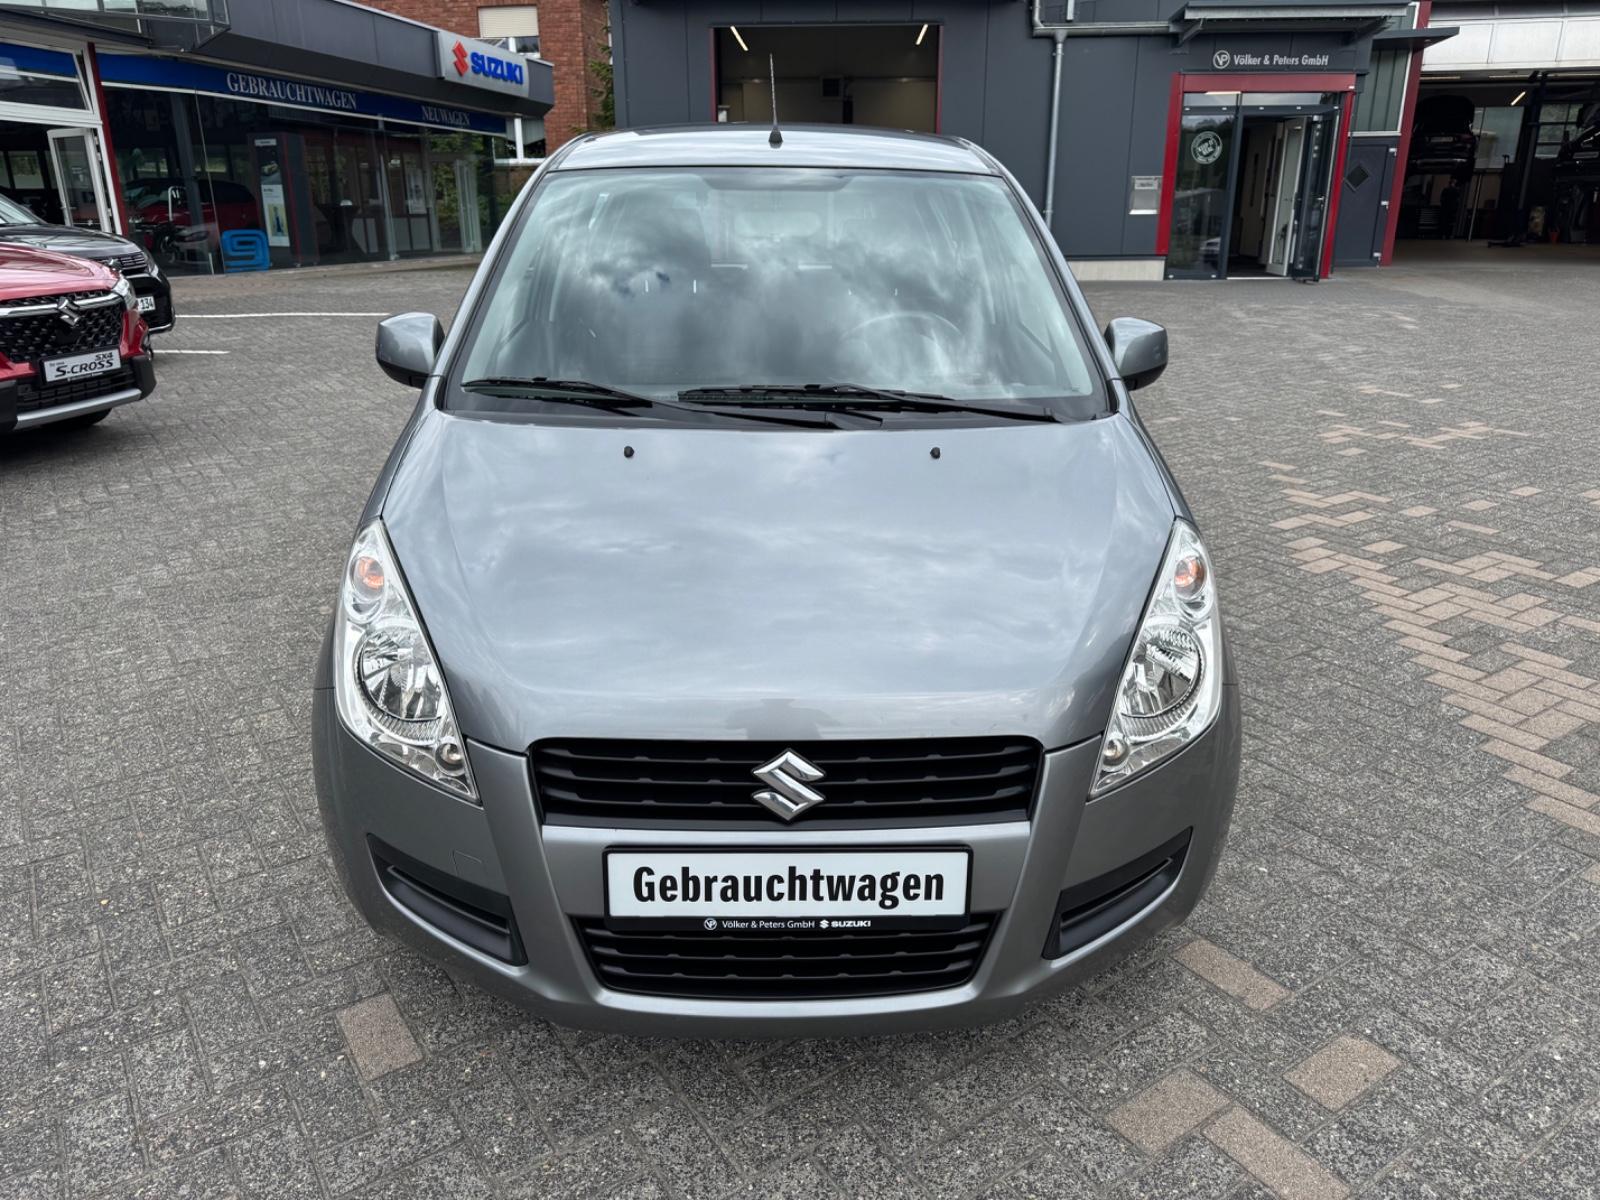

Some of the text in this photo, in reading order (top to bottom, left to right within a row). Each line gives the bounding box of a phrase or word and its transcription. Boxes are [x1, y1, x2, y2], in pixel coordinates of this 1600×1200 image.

[470, 52, 524, 85] SUZUKI
[1233, 54, 1261, 65] Völker
[1263, 54, 1270, 65] &
[1273, 54, 1300, 65] Peters
[1301, 54, 1329, 66] GmbH
[226, 72, 357, 110] GEBRAUCHTWAGEN
[421, 105, 471, 126] NEUWAGEN
[95, 352, 114, 361] SX4
[54, 360, 114, 378] S-CROSS
[633, 866, 944, 910] Gebrauchtwagen
[722, 920, 749, 929] Völker
[751, 920, 757, 929] &
[759, 920, 785, 929] Peters
[787, 920, 815, 929] GmbH
[831, 920, 871, 928] SUZUKI
